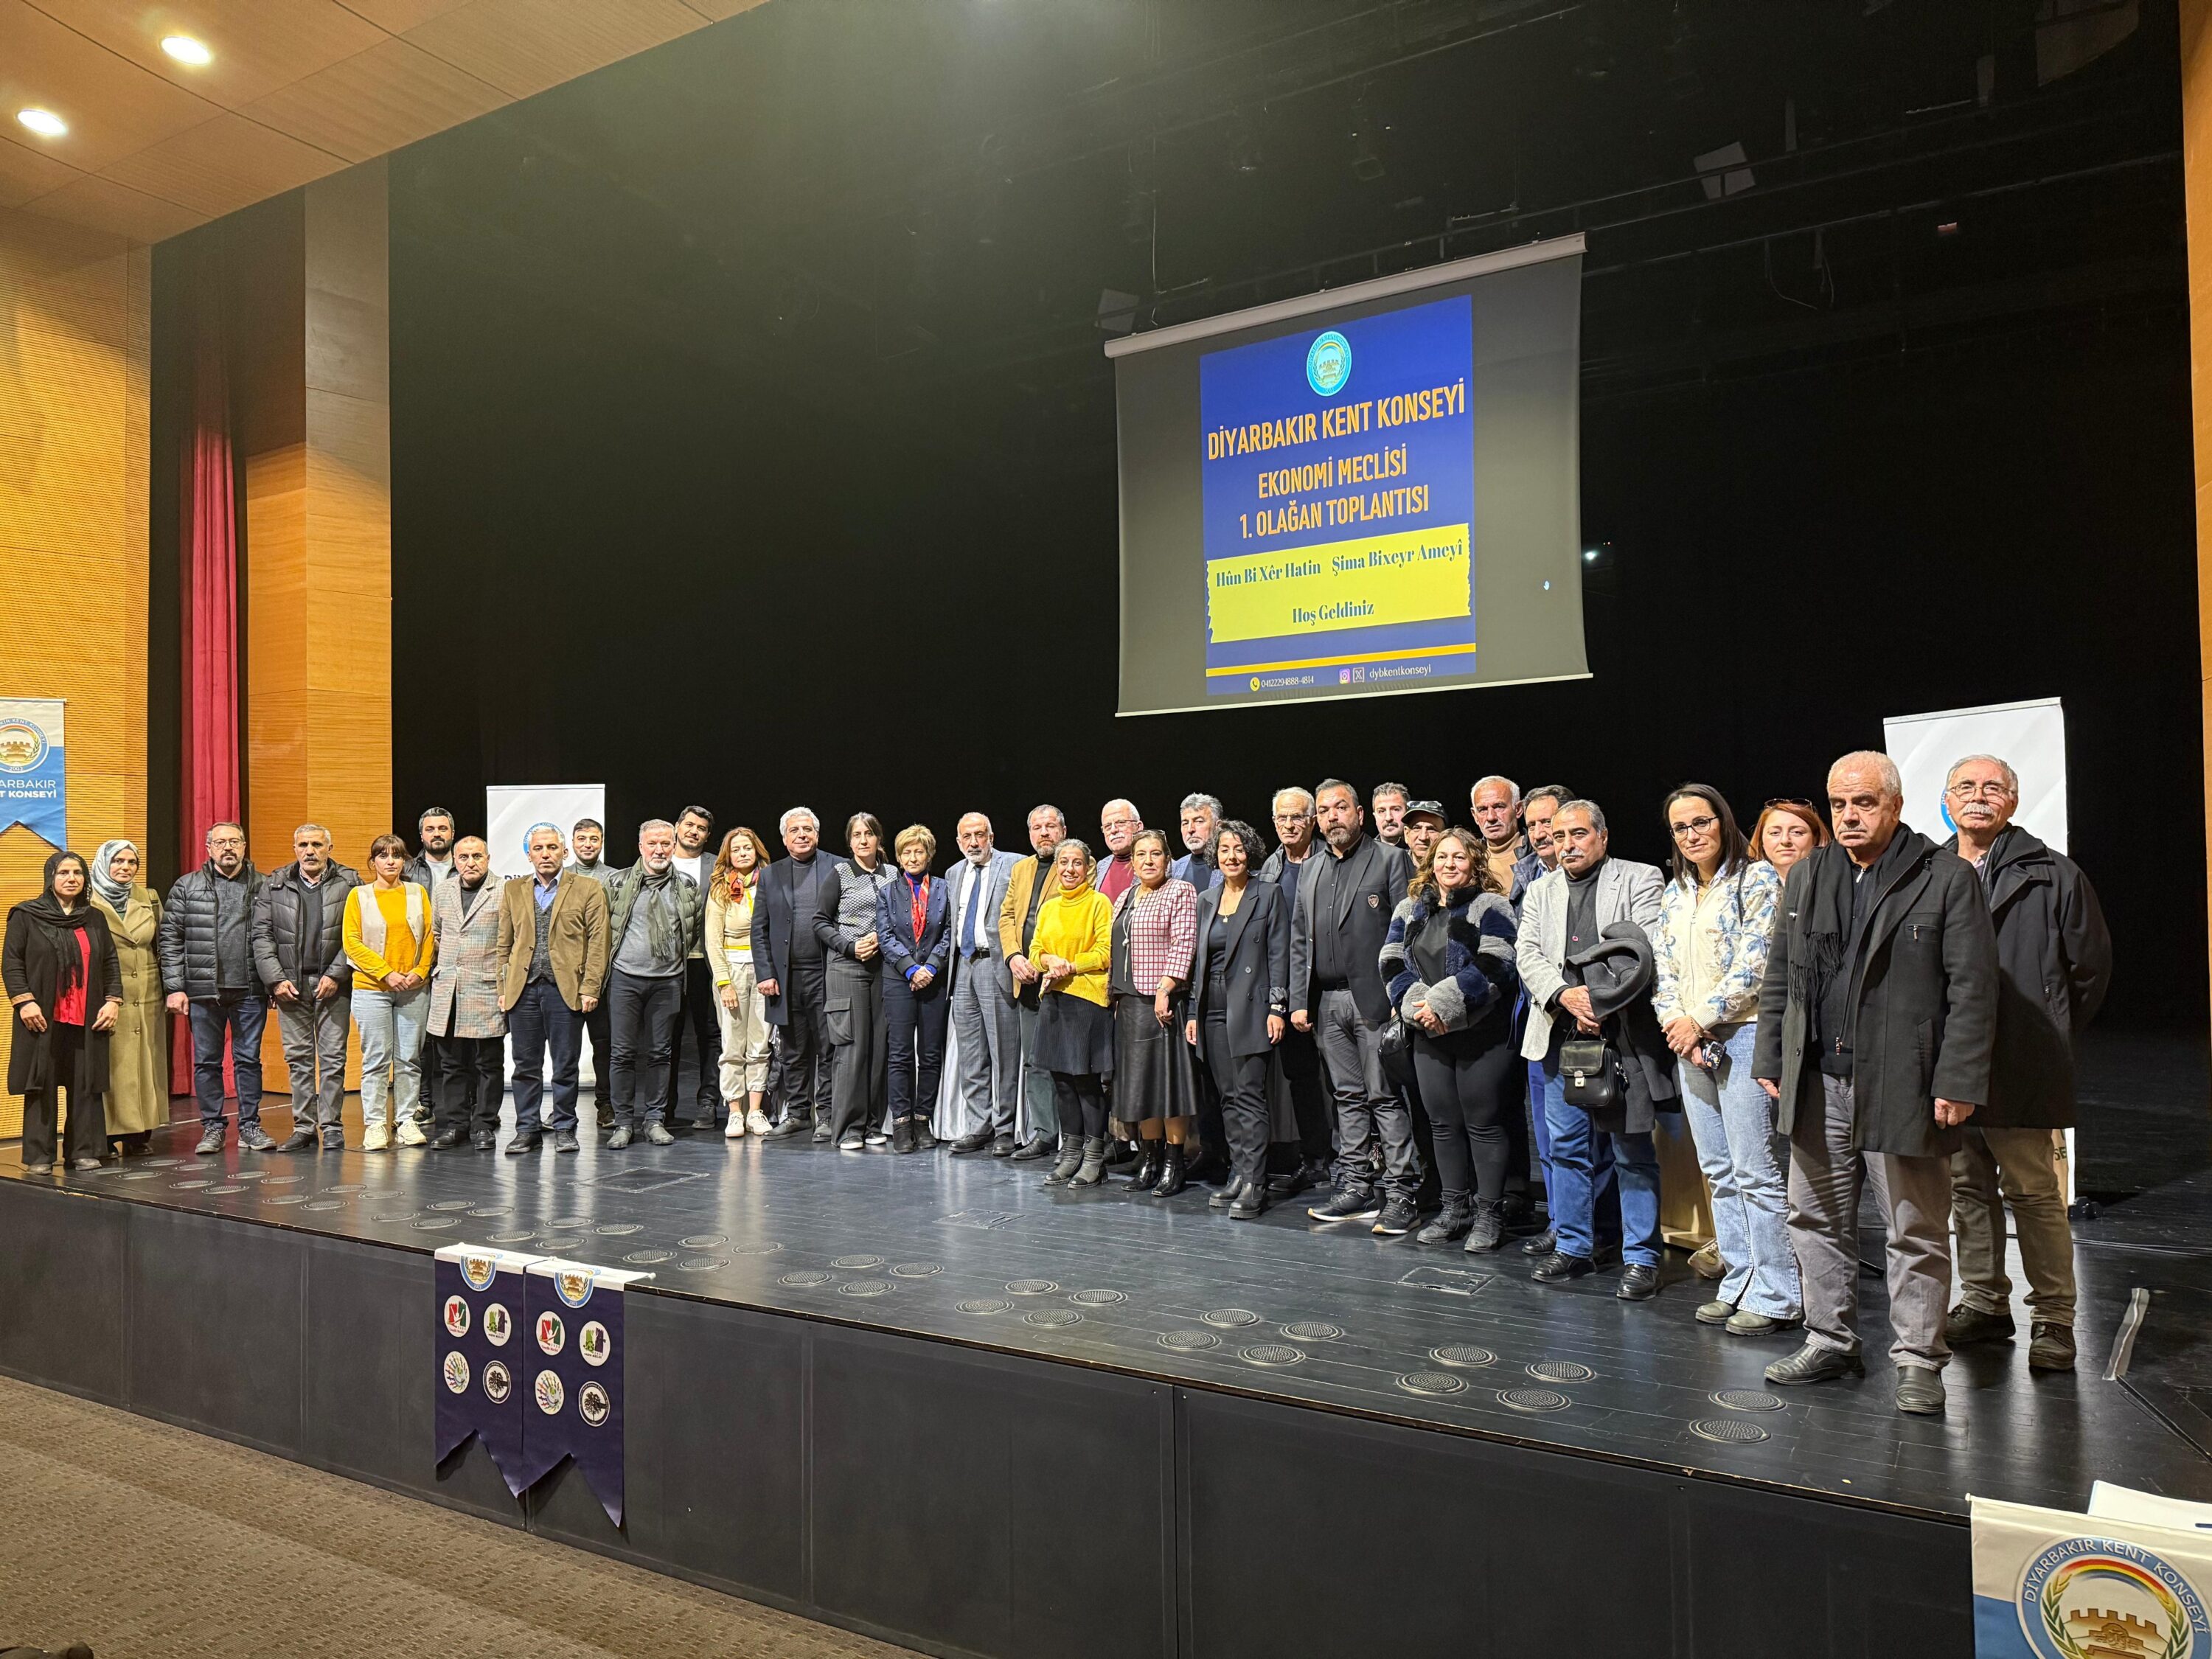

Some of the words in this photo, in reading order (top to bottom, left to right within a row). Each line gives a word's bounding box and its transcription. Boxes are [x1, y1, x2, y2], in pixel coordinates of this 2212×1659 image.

[1208, 413, 1317, 460] DİYARBAKIR
[1322, 401, 1372, 439] KENT
[1377, 378, 1464, 428] KONSEYİ
[1259, 456, 1333, 498] EKONOMİ
[1338, 443, 1407, 485] MECLİSİ
[1239, 514, 1253, 539] 1.
[1256, 500, 1322, 537] OLAĞAN
[1326, 484, 1429, 526] TOPLANTISI
[1216, 571, 1242, 587] Hûn
[1245, 567, 1256, 583] Bi
[1259, 563, 1283, 581] Xêr
[1285, 560, 1321, 578] Hatin
[1332, 554, 1366, 576] Şima
[1368, 547, 1415, 568] Bixeyr
[1417, 539, 1463, 562] Ameyî
[1293, 608, 1316, 626] Hoş
[1318, 599, 1374, 621] Geldiniz
[9, 789, 56, 798] KONSEYİ
[2023, 1539, 2096, 1603] DİYARBAKIR
[2102, 1538, 2152, 1563] KENT
[2154, 1562, 2211, 1633] KONSEYİ
